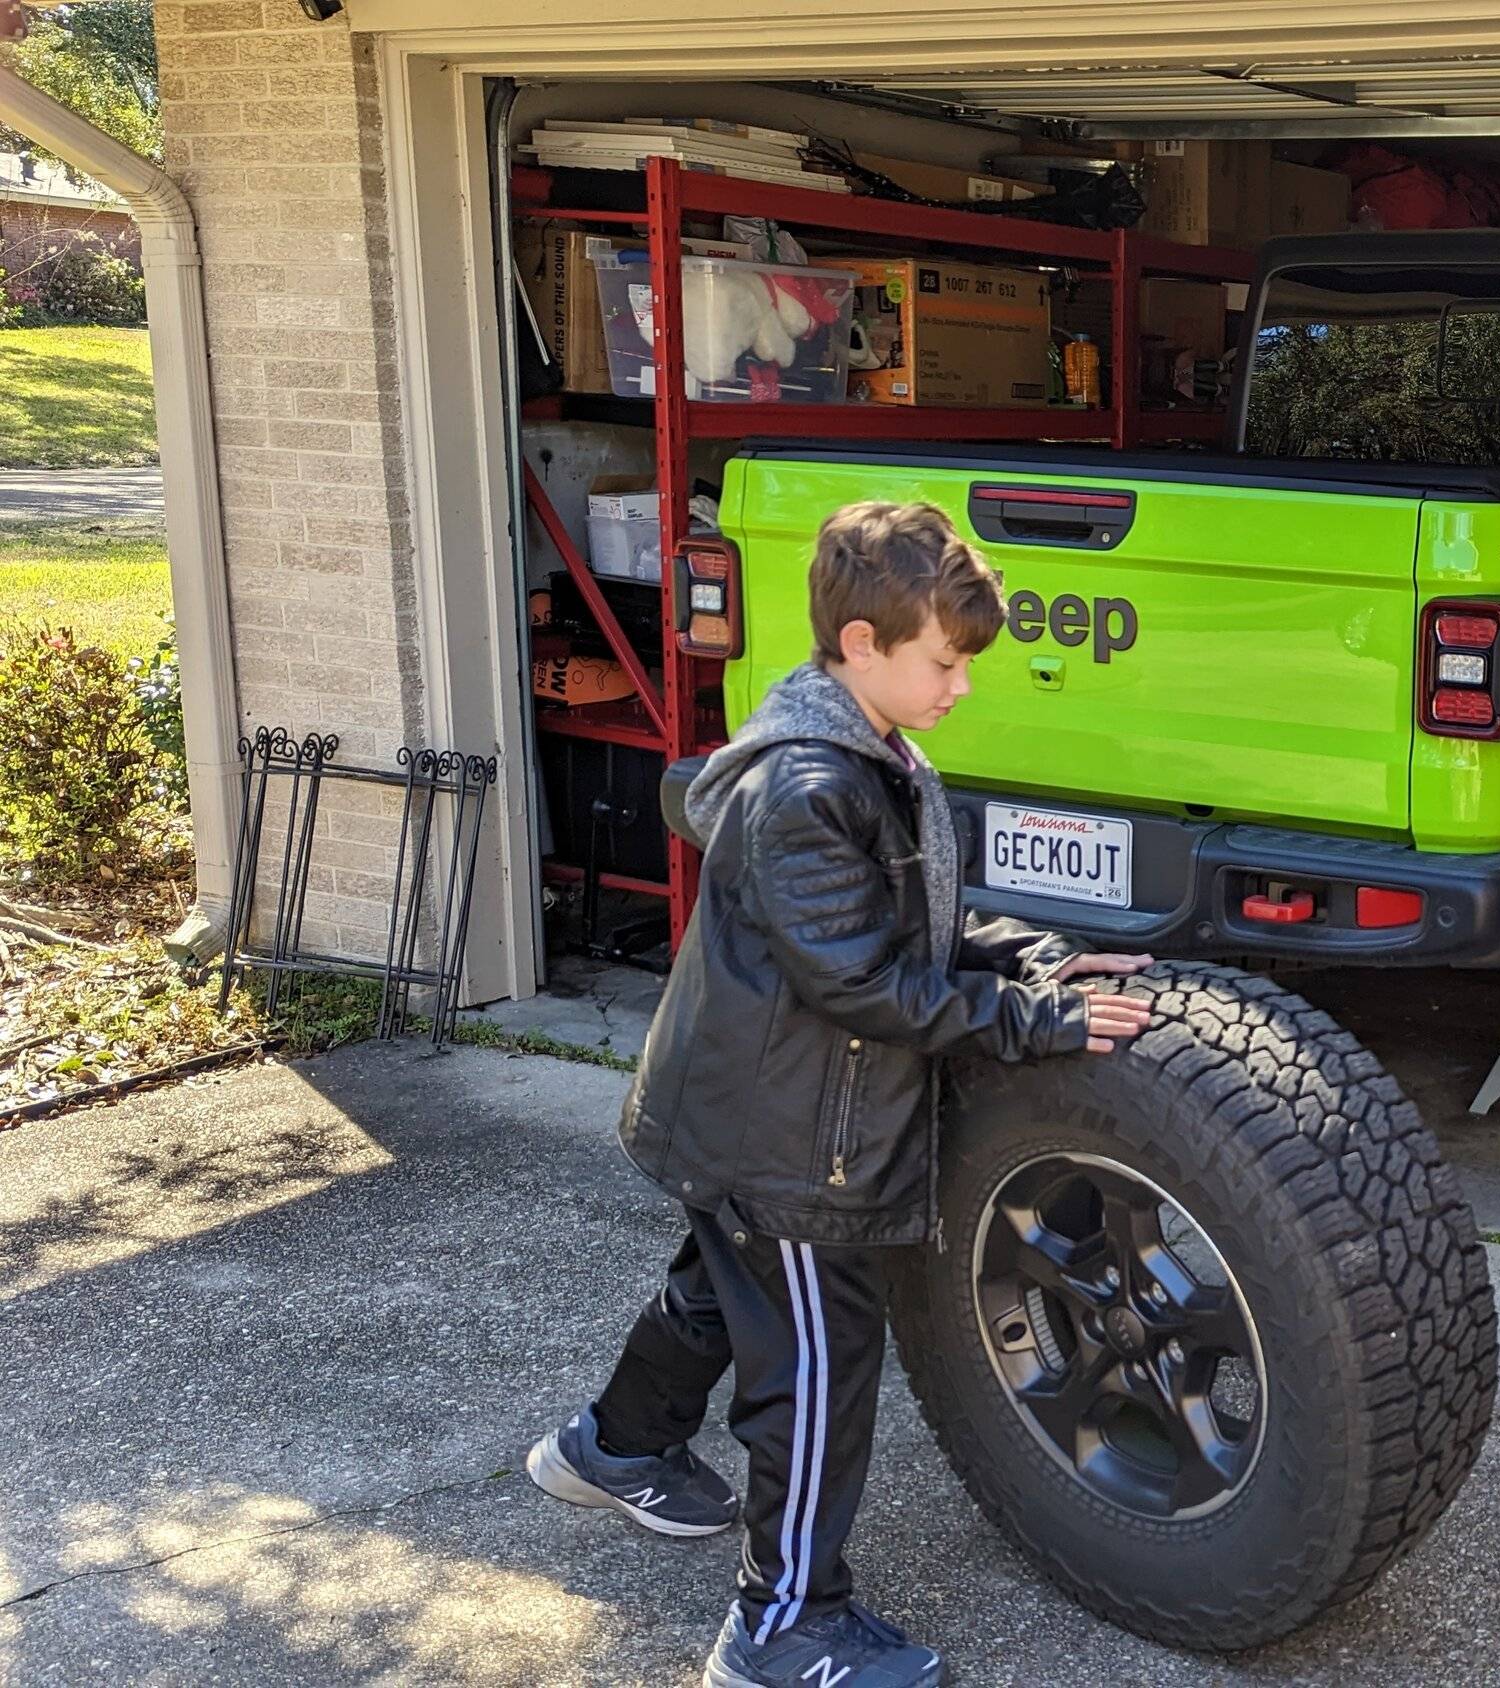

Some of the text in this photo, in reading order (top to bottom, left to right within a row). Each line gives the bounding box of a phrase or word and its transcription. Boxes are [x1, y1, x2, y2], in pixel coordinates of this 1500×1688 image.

[555, 237, 565, 279] SOUND
[554, 283, 565, 306] THE
[554, 311, 565, 326] OF
[996, 571, 1139, 664] eep
[1020, 811, 1094, 834] Louisiana
[994, 830, 1121, 883] GECKOJT
[1019, 877, 1093, 896] SPORTSMAN'S PARADISE
[1108, 888, 1122, 898] 26
[624, 1487, 668, 1508] N
[800, 1655, 851, 1688] N
